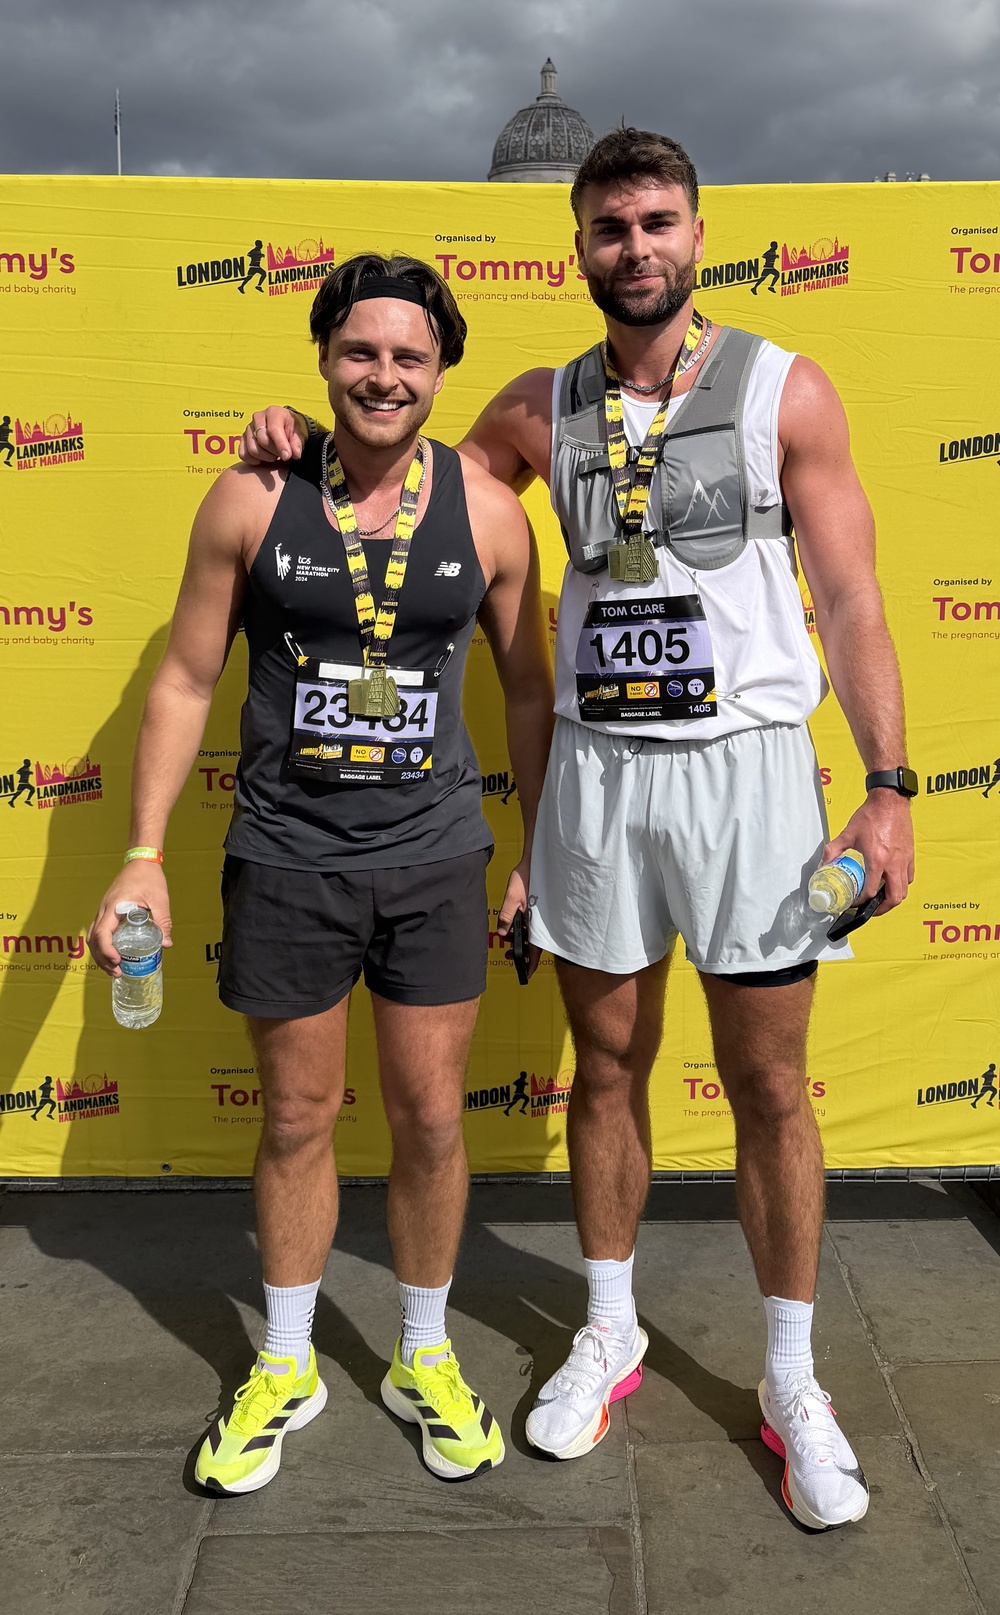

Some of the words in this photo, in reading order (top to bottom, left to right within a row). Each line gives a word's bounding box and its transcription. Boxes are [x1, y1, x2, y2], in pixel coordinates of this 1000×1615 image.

[951, 226, 998, 236] Organised
[435, 234, 482, 243] Organised
[485, 234, 496, 243] by
[177, 256, 245, 287] LONDON
[435, 254, 587, 288] Tommy'
[781, 260, 849, 286] LANDMARKS
[14, 284, 39, 295] baby
[42, 284, 76, 295] charity
[268, 283, 288, 296] HALF
[781, 284, 801, 297] HALF
[803, 274, 849, 292] MARATHON
[949, 285, 966, 293] The
[457, 293, 508, 301] pregnancy
[510, 292, 529, 300] and
[531, 292, 556, 301] baby
[559, 291, 592, 301] charity
[183, 410, 230, 418] Organised
[233, 410, 244, 419] by
[16, 437, 84, 459] LANDMARKS
[17, 458, 38, 470] HALF
[40, 450, 85, 467] MARATHON
[185, 465, 203, 474] The
[933, 578, 978, 586] Organised
[981, 578, 992, 586] by
[601, 606, 628, 617] TOM
[630, 603, 666, 615] CLARE
[12, 636, 30, 644] and
[33, 636, 58, 645] baby
[61, 636, 95, 645] charity
[932, 631, 948, 639] The
[950, 632, 1000, 640] pregnancy
[589, 628, 690, 668] 1405
[688, 704, 711, 714] 1405
[400, 771, 425, 780] 23434
[926, 765, 990, 794] LONDON
[37, 777, 102, 799] LANDMARKS
[38, 798, 57, 809] HALF
[59, 790, 103, 806] MARATHON
[200, 801, 217, 809] The
[923, 902, 967, 910] Organised
[969, 902, 980, 910] by
[940, 952, 988, 960] pregnancy
[53, 963, 77, 972] baby
[210, 1067, 254, 1075] Organised
[917, 1078, 979, 1105] LONDON
[58, 1093, 119, 1113] LANDMARKS
[59, 1113, 77, 1123] HALF
[80, 1105, 119, 1119] MARATHON
[531, 1107, 549, 1118] HALF
